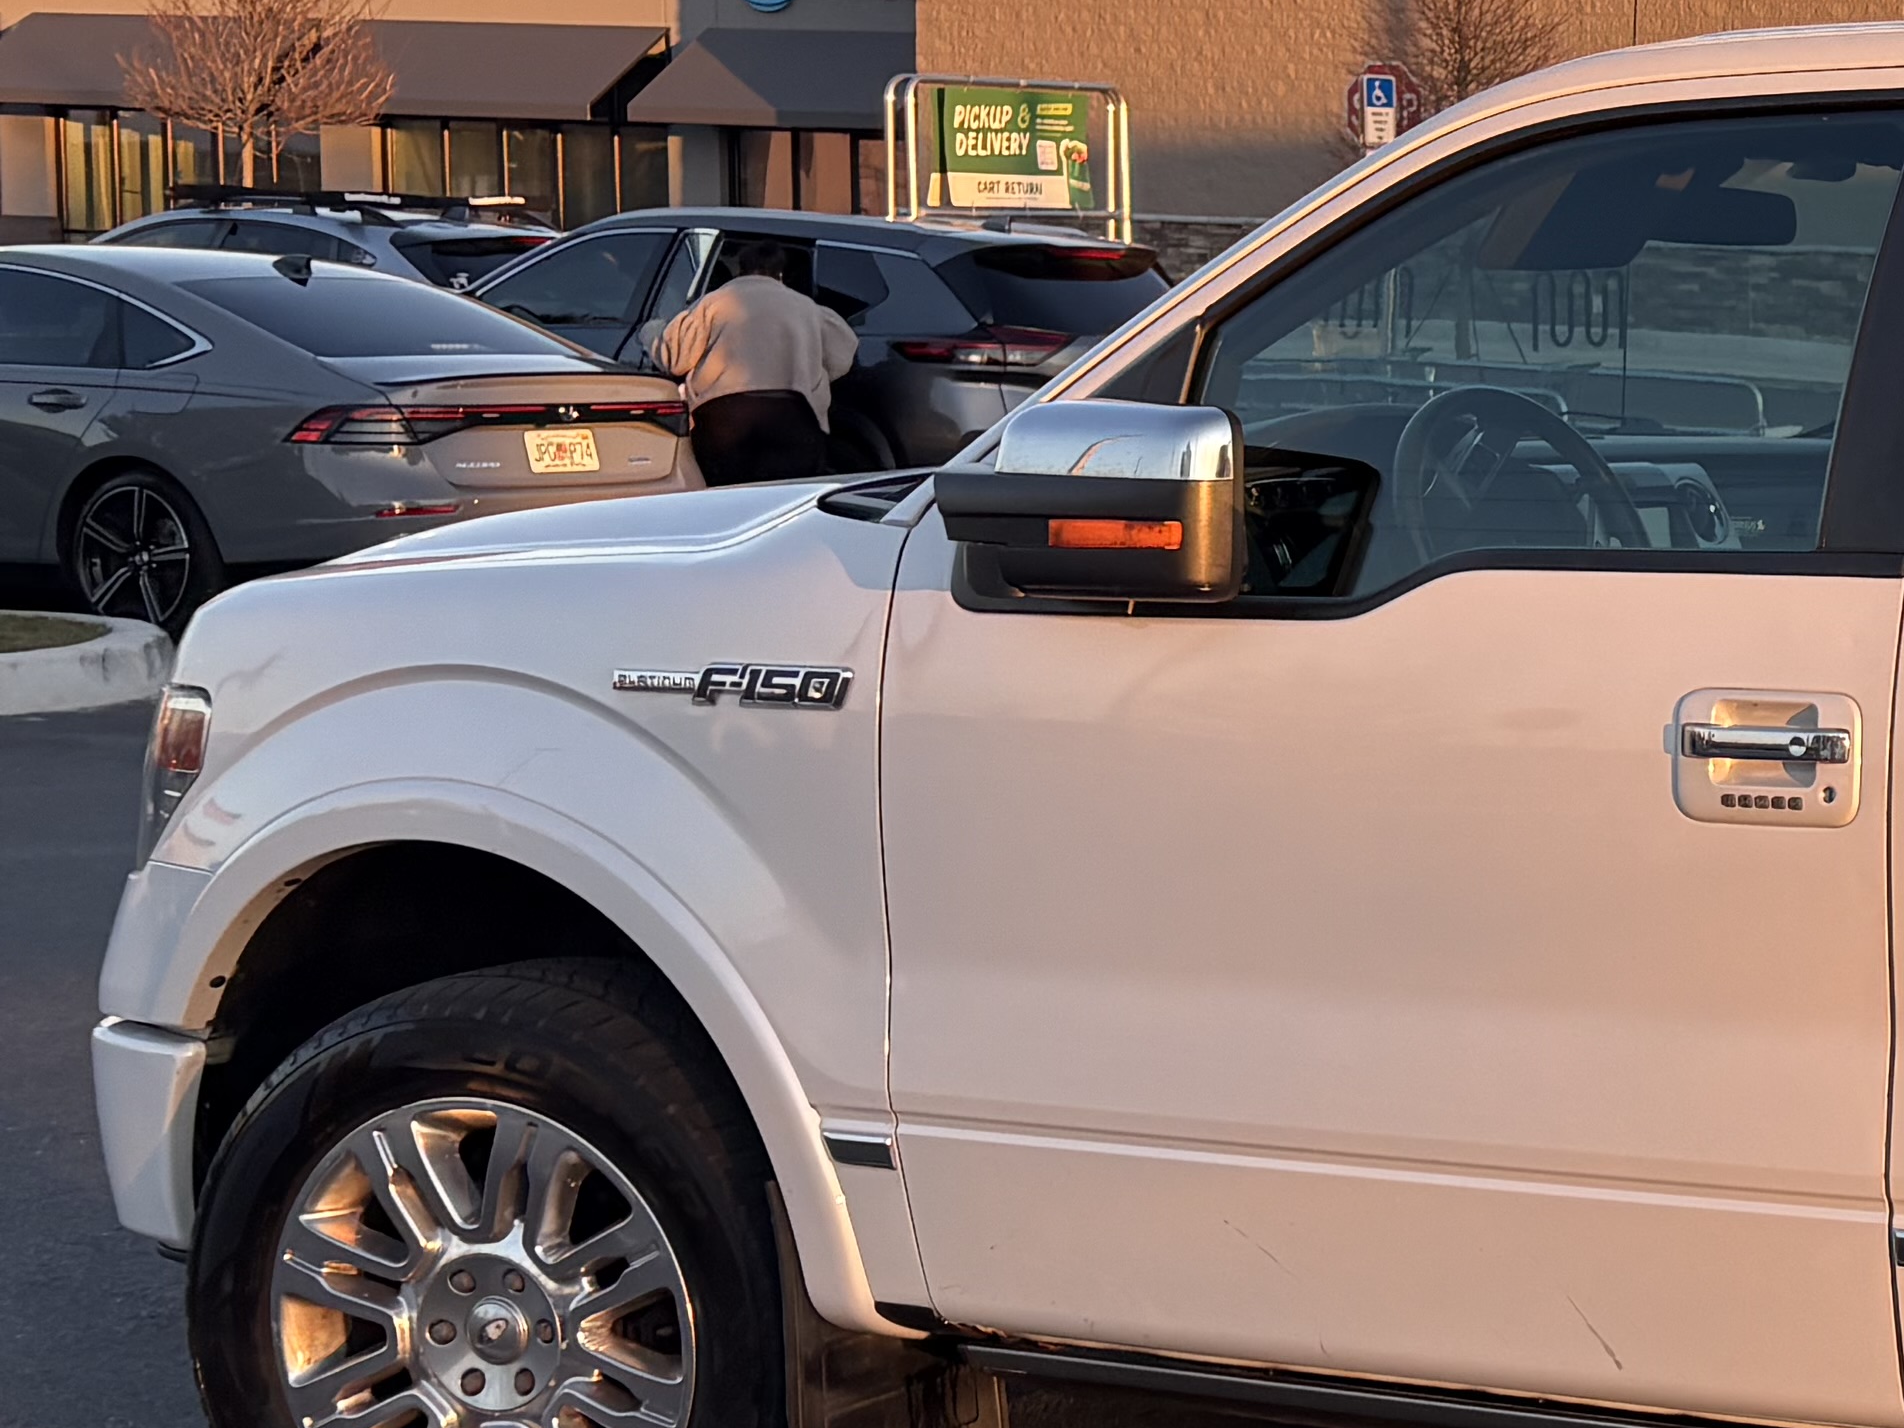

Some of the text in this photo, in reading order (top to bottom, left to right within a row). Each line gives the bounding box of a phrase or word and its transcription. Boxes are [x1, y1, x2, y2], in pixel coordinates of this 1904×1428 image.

[953, 104, 1013, 130] PICKUP
[1017, 103, 1031, 129] &
[955, 131, 1030, 157] DELIVERY
[977, 180, 1043, 196] CART RETURN
[616, 672, 696, 690] PLATINUM
